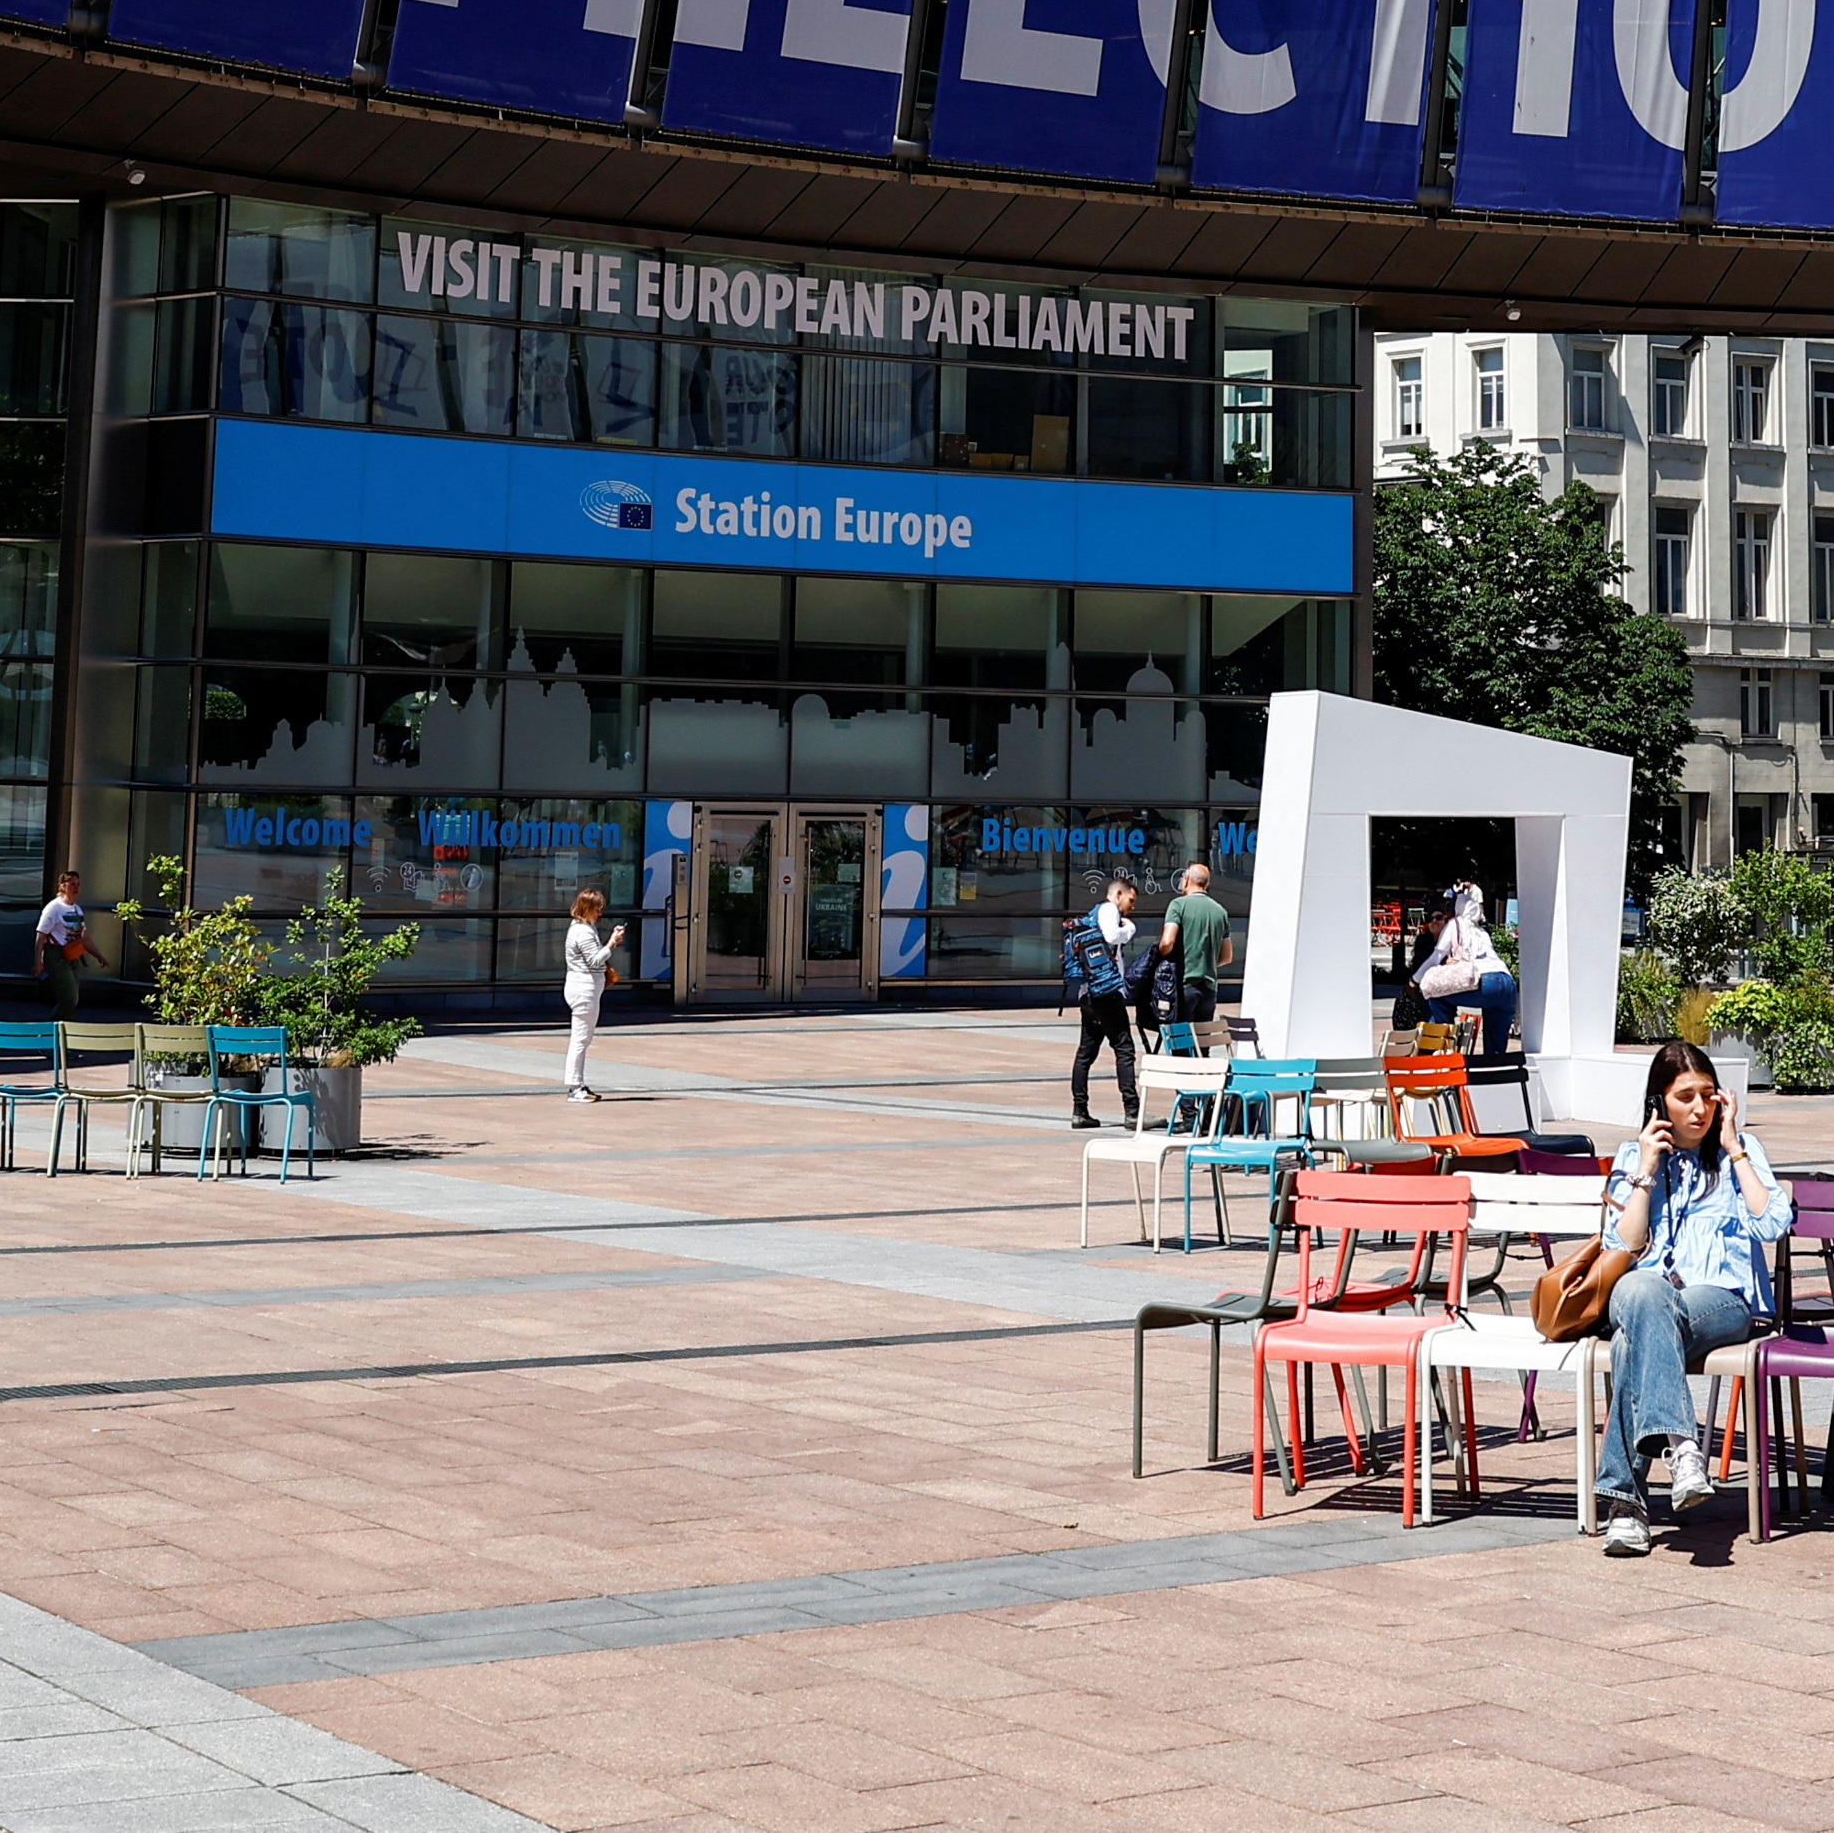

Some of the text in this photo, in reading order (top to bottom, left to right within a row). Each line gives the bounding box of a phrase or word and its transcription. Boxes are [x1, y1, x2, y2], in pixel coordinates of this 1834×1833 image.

[397, 232, 1194, 360] VISIT THE EUROPEAN PARLIAMENT
[675, 487, 972, 558] Station Europe
[225, 807, 621, 849] Welcome Willkommen
[982, 817, 1259, 855] Bienvenue We
